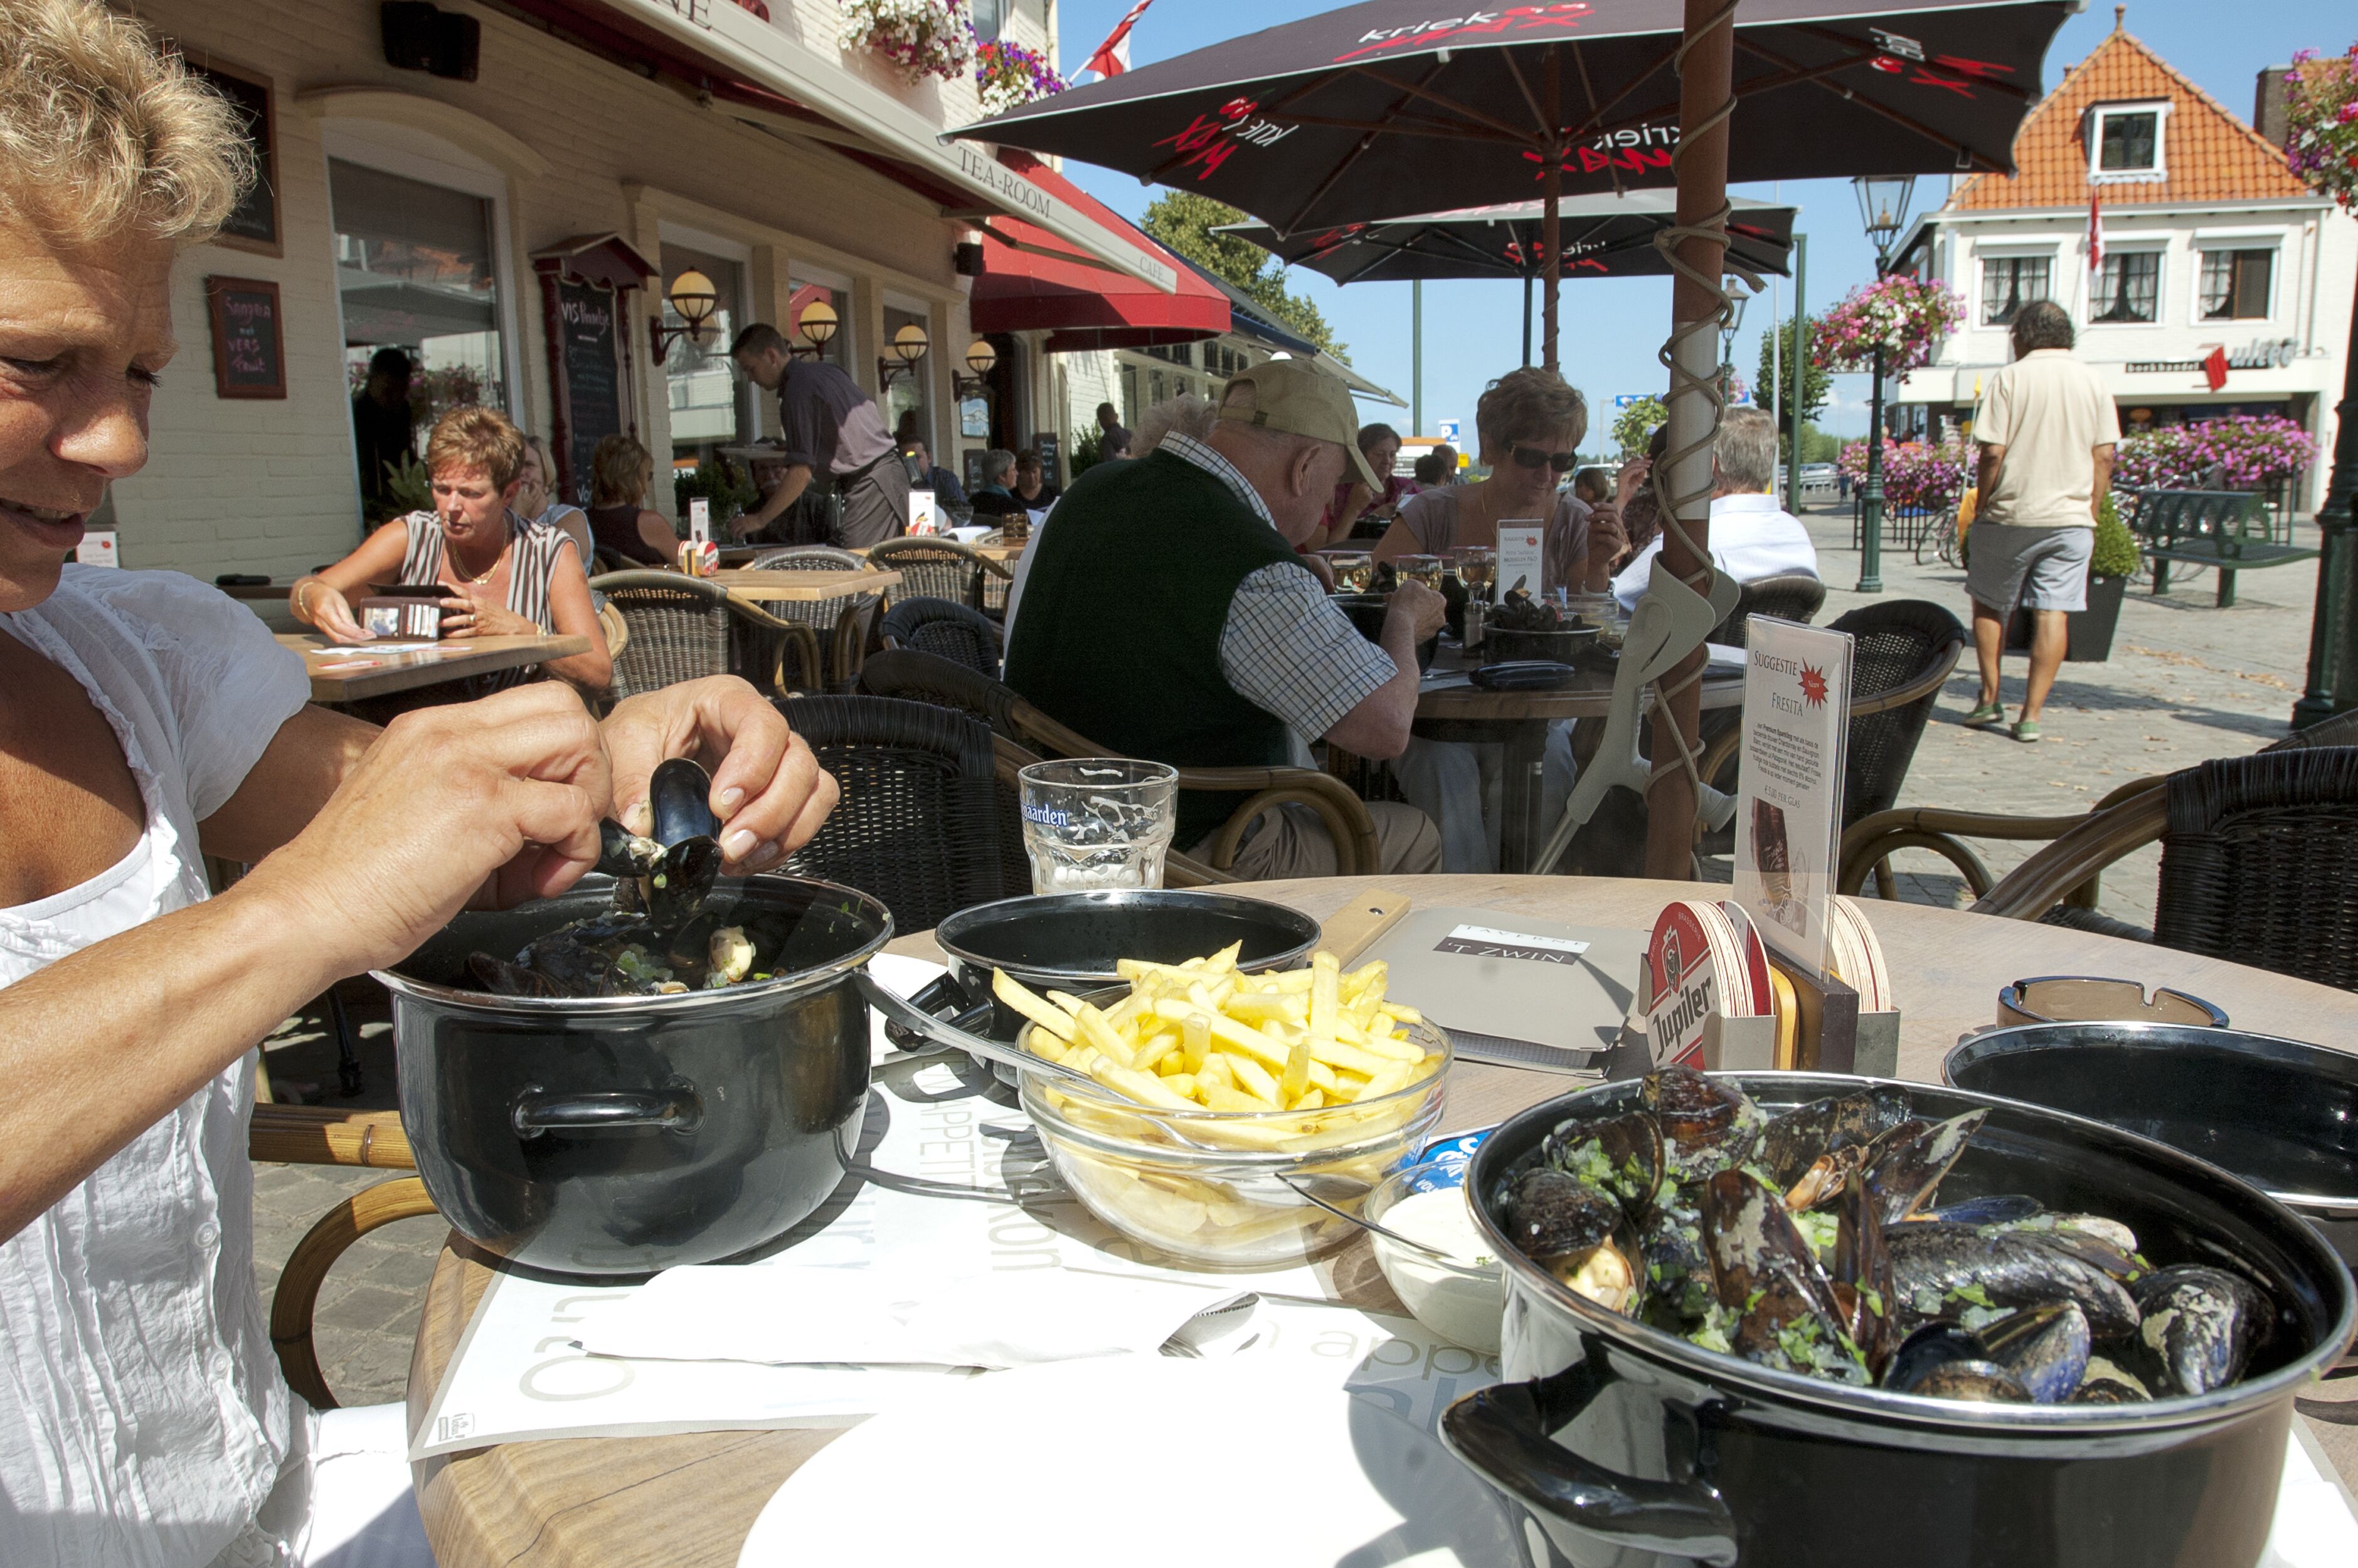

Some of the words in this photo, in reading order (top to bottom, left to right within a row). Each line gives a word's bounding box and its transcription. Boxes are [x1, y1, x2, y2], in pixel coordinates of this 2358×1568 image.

[2127, 362, 2199, 372] boekhandel
[1754, 650, 1798, 676] SUGGESTIE
[1771, 692, 1803, 717] FRESITA
[1763, 724, 1776, 734] Premium
[1776, 729, 1792, 741] Sparkling
[1778, 792, 1787, 803] PER
[1788, 796, 1800, 808] GLAS
[1677, 911, 1702, 943] BRASSERIE
[1478, 946, 1565, 963] ZWIN
[1652, 976, 1712, 1063] Jupiler
[919, 1095, 977, 1192] APPETIT
